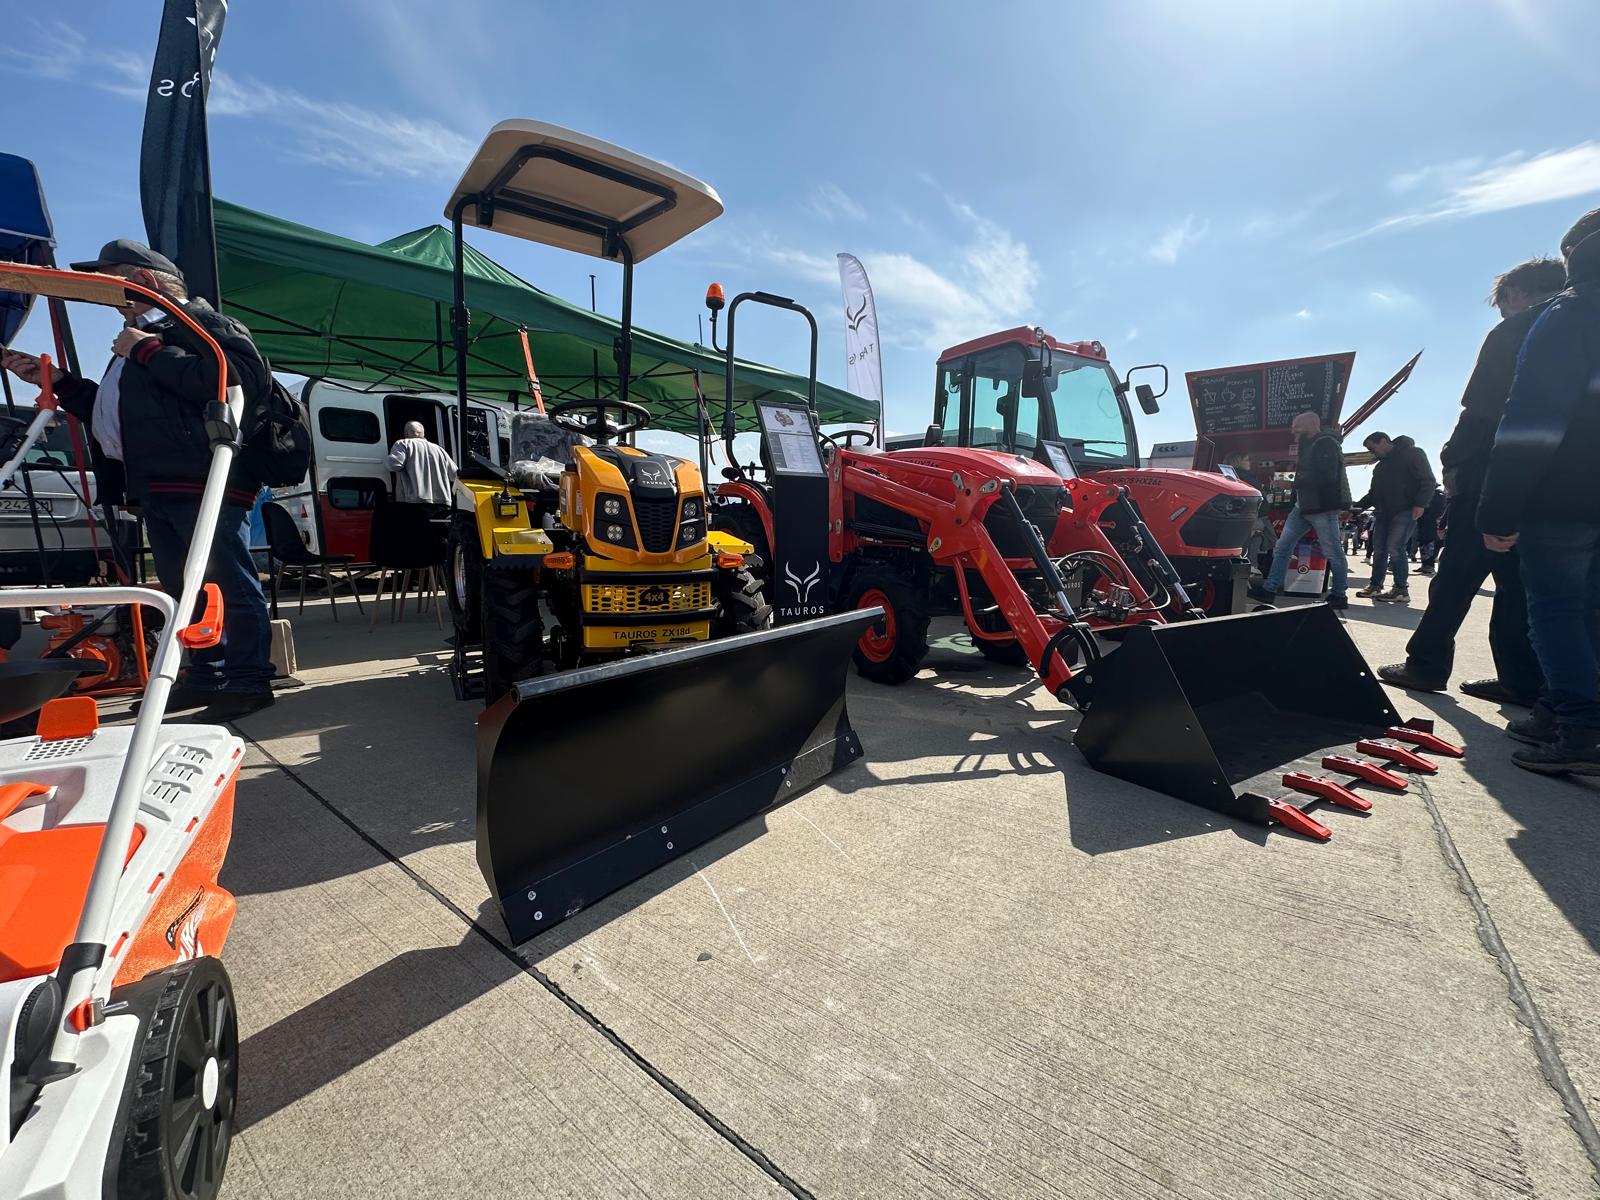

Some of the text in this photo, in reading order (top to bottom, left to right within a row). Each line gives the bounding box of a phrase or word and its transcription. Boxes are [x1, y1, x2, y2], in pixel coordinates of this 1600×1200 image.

[644, 592, 665, 602] 4x4
[780, 605, 825, 616] TAUROS
[613, 627, 690, 640] TAUROS ZX18d
